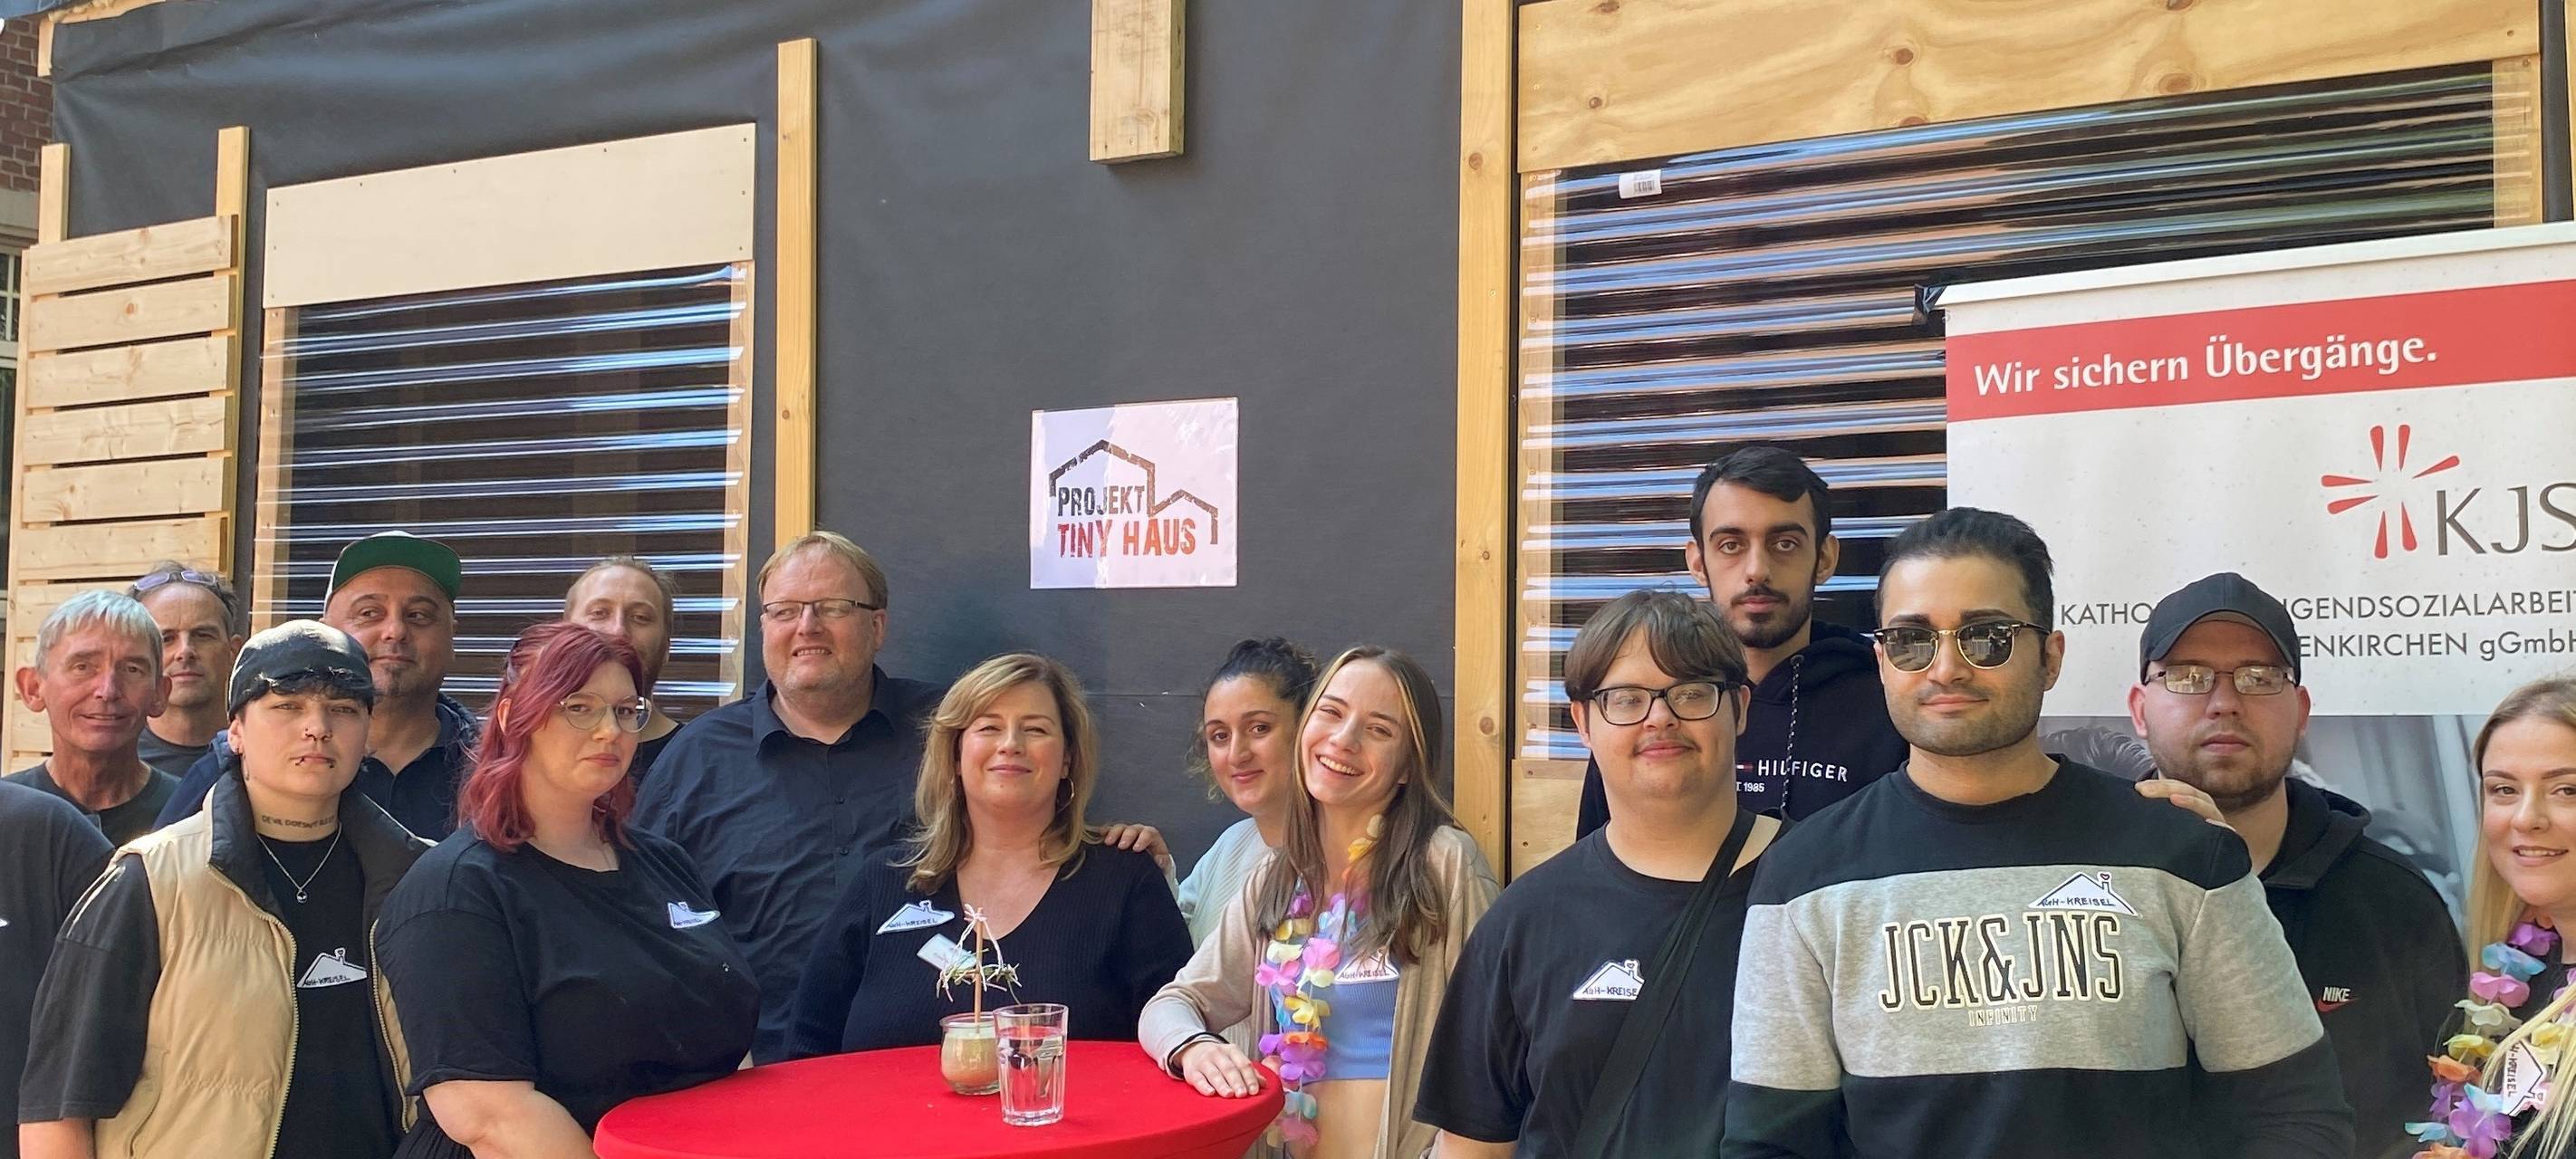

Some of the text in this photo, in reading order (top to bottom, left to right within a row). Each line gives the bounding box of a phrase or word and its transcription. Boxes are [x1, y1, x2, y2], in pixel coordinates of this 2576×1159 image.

[1973, 334, 2438, 396] Wir sichern Übergänge.
[1057, 485, 1145, 517] PROJEKT
[2436, 482, 2576, 556] KJS
[1057, 518, 1197, 559] TINY HAUS
[2283, 590, 2576, 619] GENDSOZIALARBEI
[2298, 633, 2467, 657] ENKIRCHEN
[1758, 760, 1848, 782] HILFIGER
[1744, 782, 1765, 792] 1985
[1879, 911, 2124, 1012] JCK&JNS
[2322, 986, 2350, 1002] NIKE
[1968, 1005, 2038, 1027] INFINITY
